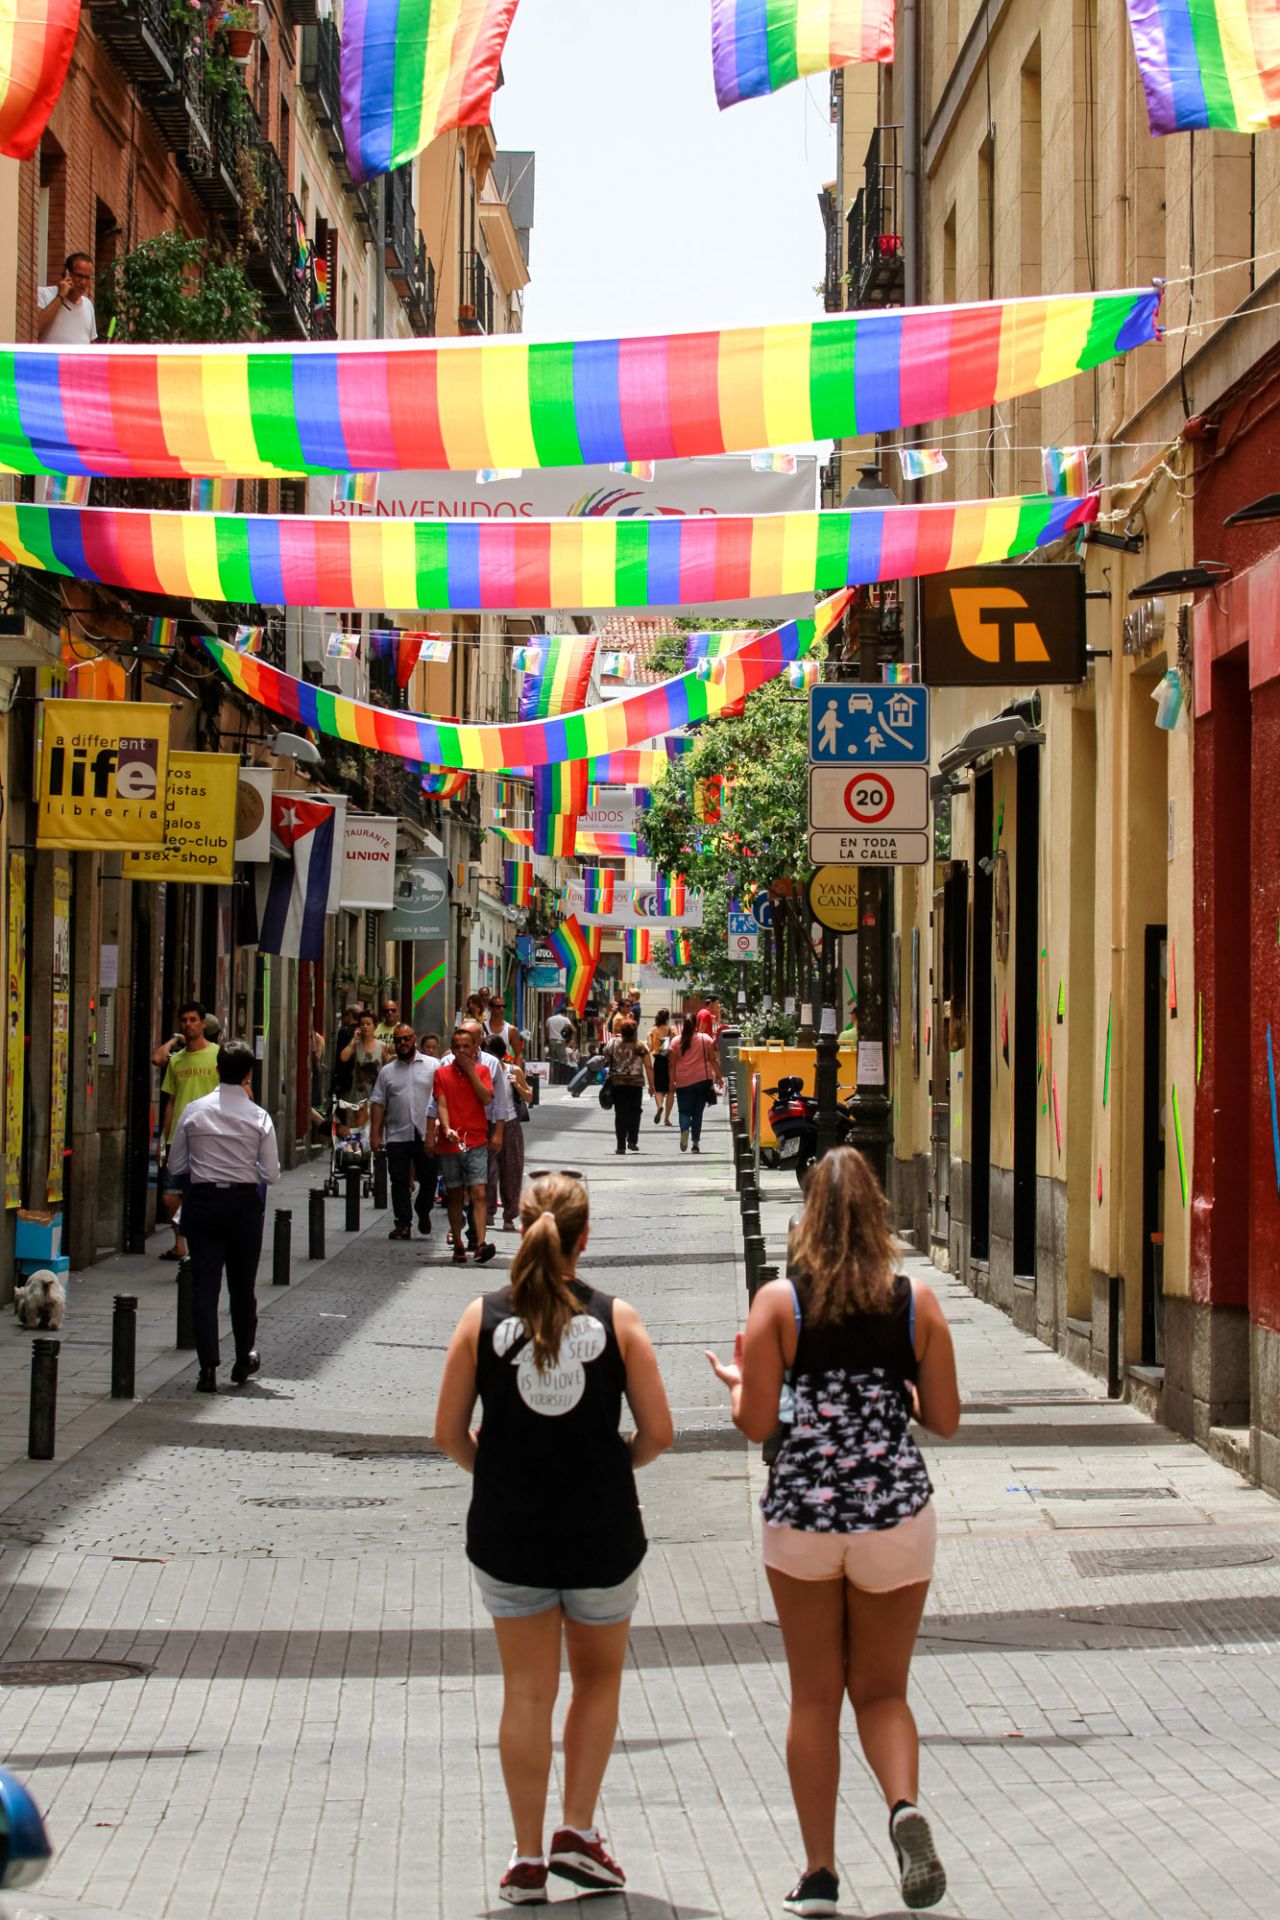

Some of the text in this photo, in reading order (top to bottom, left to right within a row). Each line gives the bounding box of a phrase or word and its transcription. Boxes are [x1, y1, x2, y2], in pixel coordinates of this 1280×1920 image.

[56, 734, 146, 750] a different
[49, 747, 157, 800] life
[856, 789, 884, 806] 20
[47, 802, 157, 819] librería
[344, 829, 391, 848] TAURANTE
[840, 838, 897, 847] EN TODA
[144, 851, 218, 866] sex-shop
[839, 849, 898, 859] LA CALLE
[554, 1369, 582, 1391] LOVE
